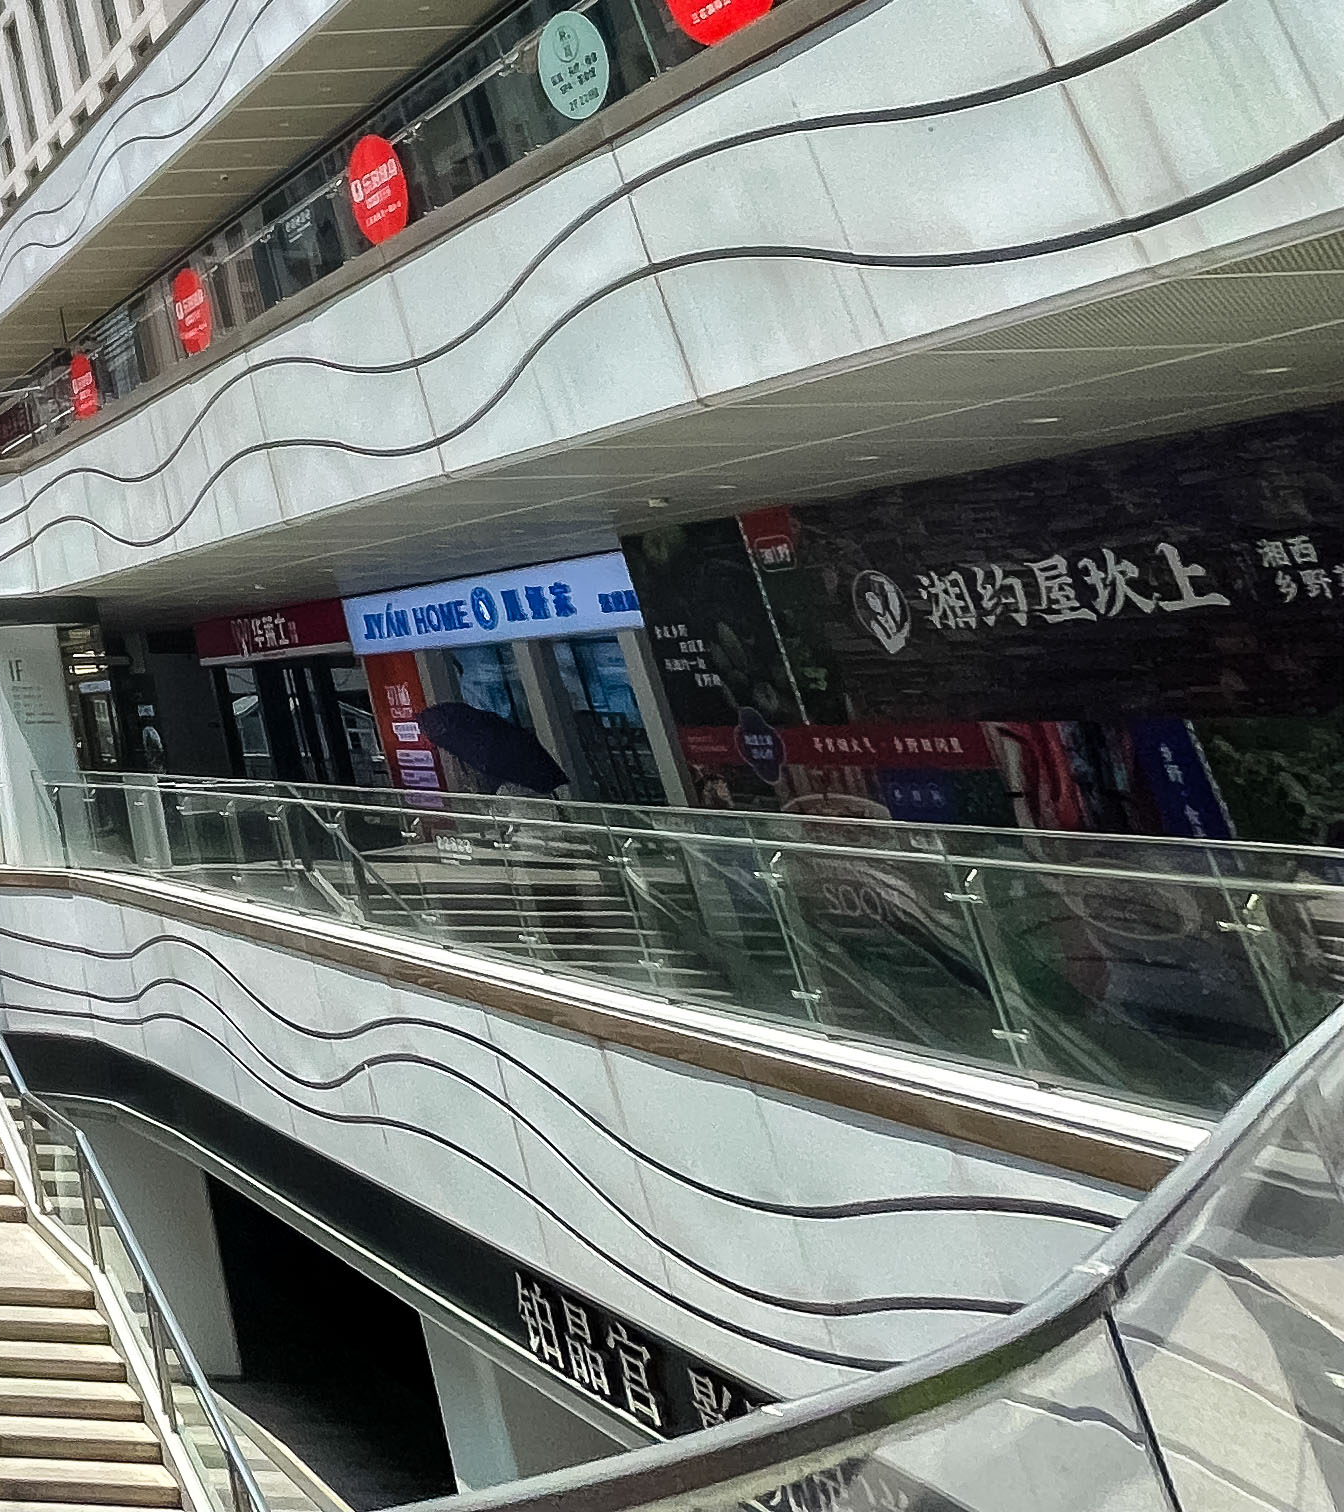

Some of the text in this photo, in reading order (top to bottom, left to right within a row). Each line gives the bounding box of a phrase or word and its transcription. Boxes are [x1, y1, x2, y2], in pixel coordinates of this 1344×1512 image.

[916, 540, 1231, 630] 湘约屋坎上
[412, 600, 474, 635] HOME
